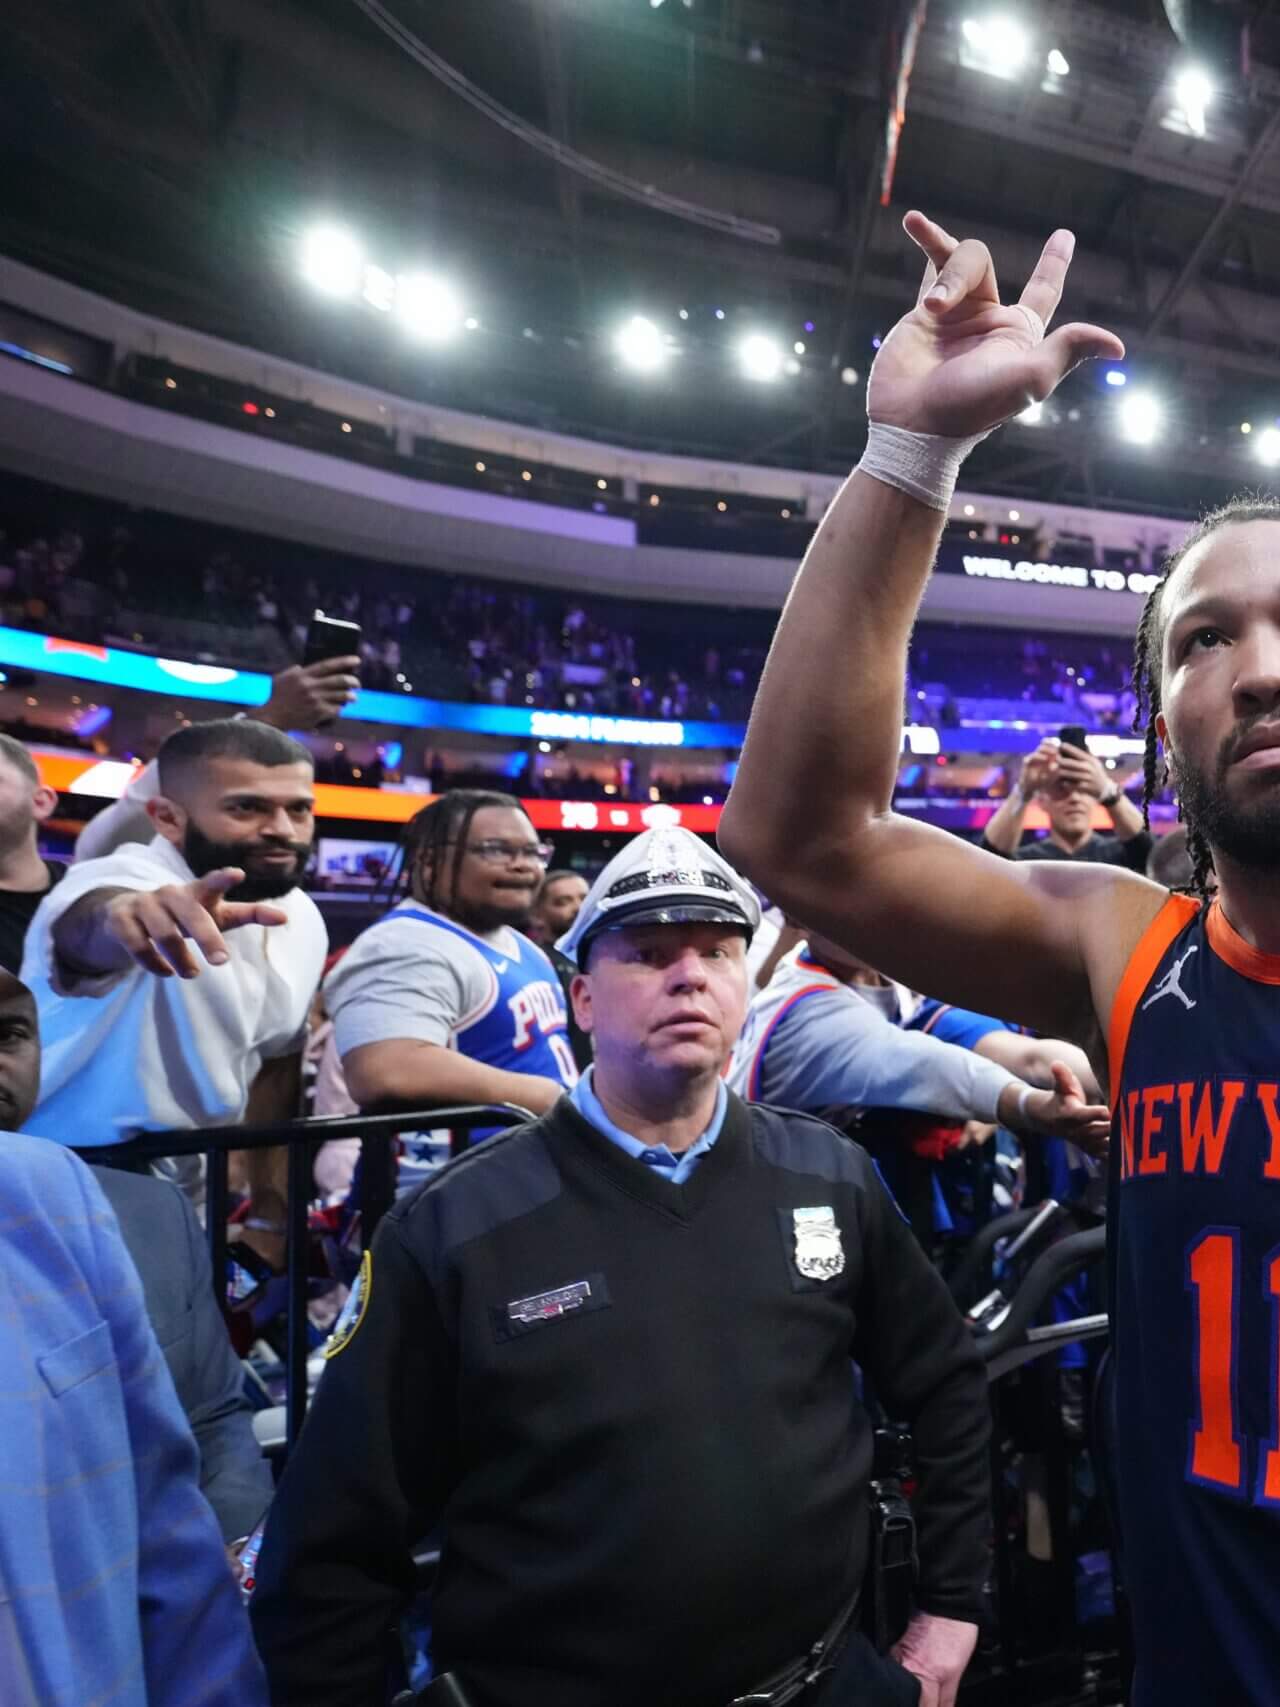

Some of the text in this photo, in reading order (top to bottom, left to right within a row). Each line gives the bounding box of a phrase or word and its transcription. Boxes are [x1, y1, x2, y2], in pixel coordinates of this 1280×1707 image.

[963, 556, 1088, 588] WELCOME
[1090, 569, 1126, 591] TO
[508, 981, 568, 1050] PHIL
[1120, 1081, 1245, 1181] NEW
